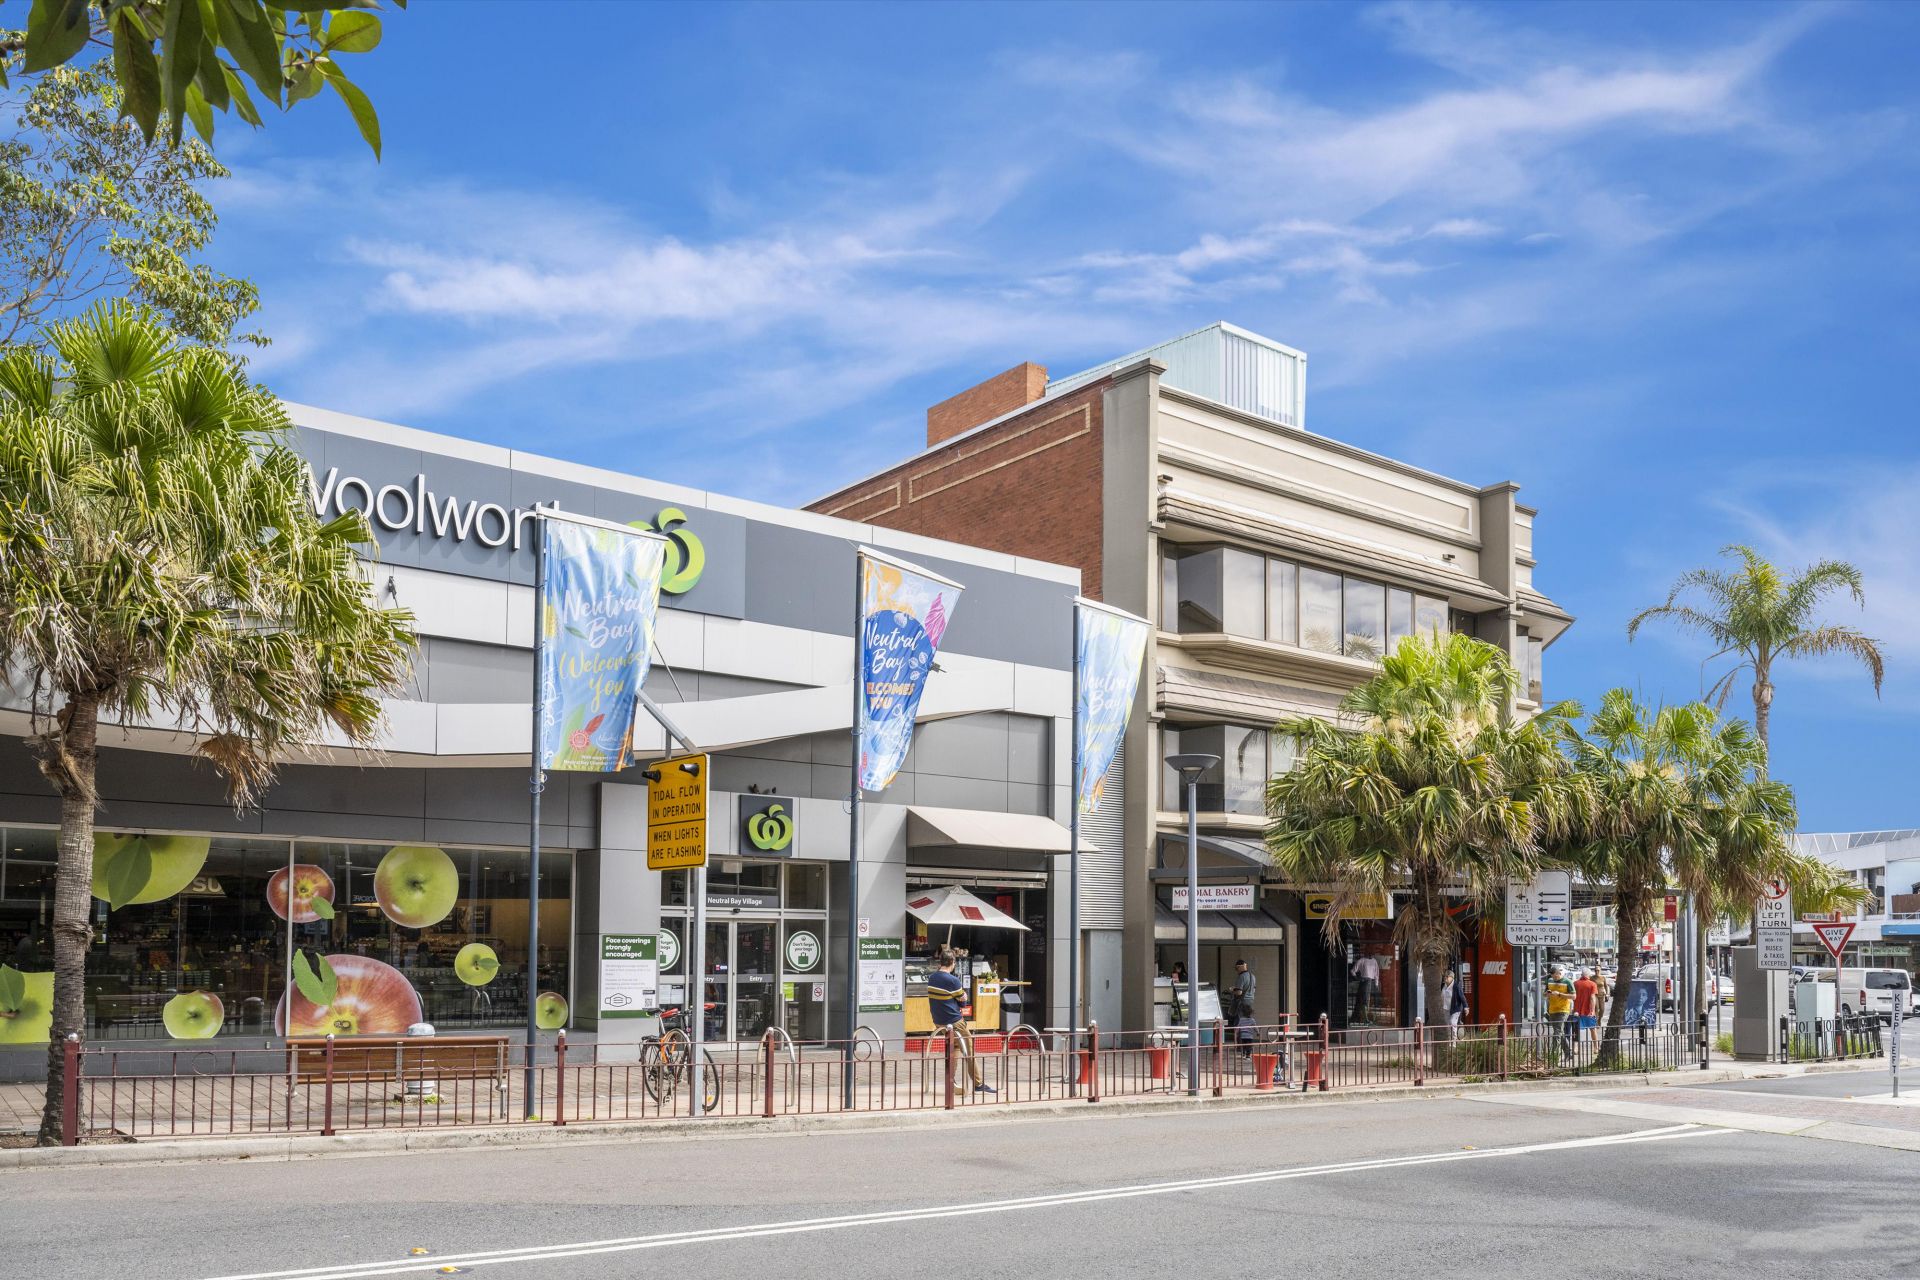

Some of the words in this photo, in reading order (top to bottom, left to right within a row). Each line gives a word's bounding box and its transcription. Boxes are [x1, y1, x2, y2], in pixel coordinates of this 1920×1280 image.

[307, 467, 560, 550] woolwor
[563, 589, 648, 624] Neutral
[586, 617, 638, 651] Bay
[866, 621, 922, 651] Neutral
[559, 651, 646, 679] Welcomes
[872, 648, 907, 681] Bay
[589, 674, 625, 713] You
[653, 789, 676, 802] TIDAL
[680, 784, 701, 798] FLOW
[652, 808, 660, 819] IN
[663, 802, 701, 818] OPERATION
[653, 830, 672, 842] WHEN
[675, 827, 699, 840] LIGHTS
[651, 848, 664, 860] ARE
[667, 845, 701, 859] FLASHING
[1215, 887, 1250, 897] BAKERY
[707, 896, 730, 905] Neutral
[730, 897, 742, 906] Bay
[742, 898, 763, 906] Village
[1765, 901, 1783, 911] NO
[605, 936, 621, 944] Face
[621, 937, 651, 946] coverings
[605, 944, 632, 952] strongly
[876, 943, 900, 951] distancing
[605, 951, 643, 959] encouraged
[1482, 961, 1508, 975] NIKE
[749, 975, 763, 983] Entry
[1893, 993, 1901, 1030] KEEP
